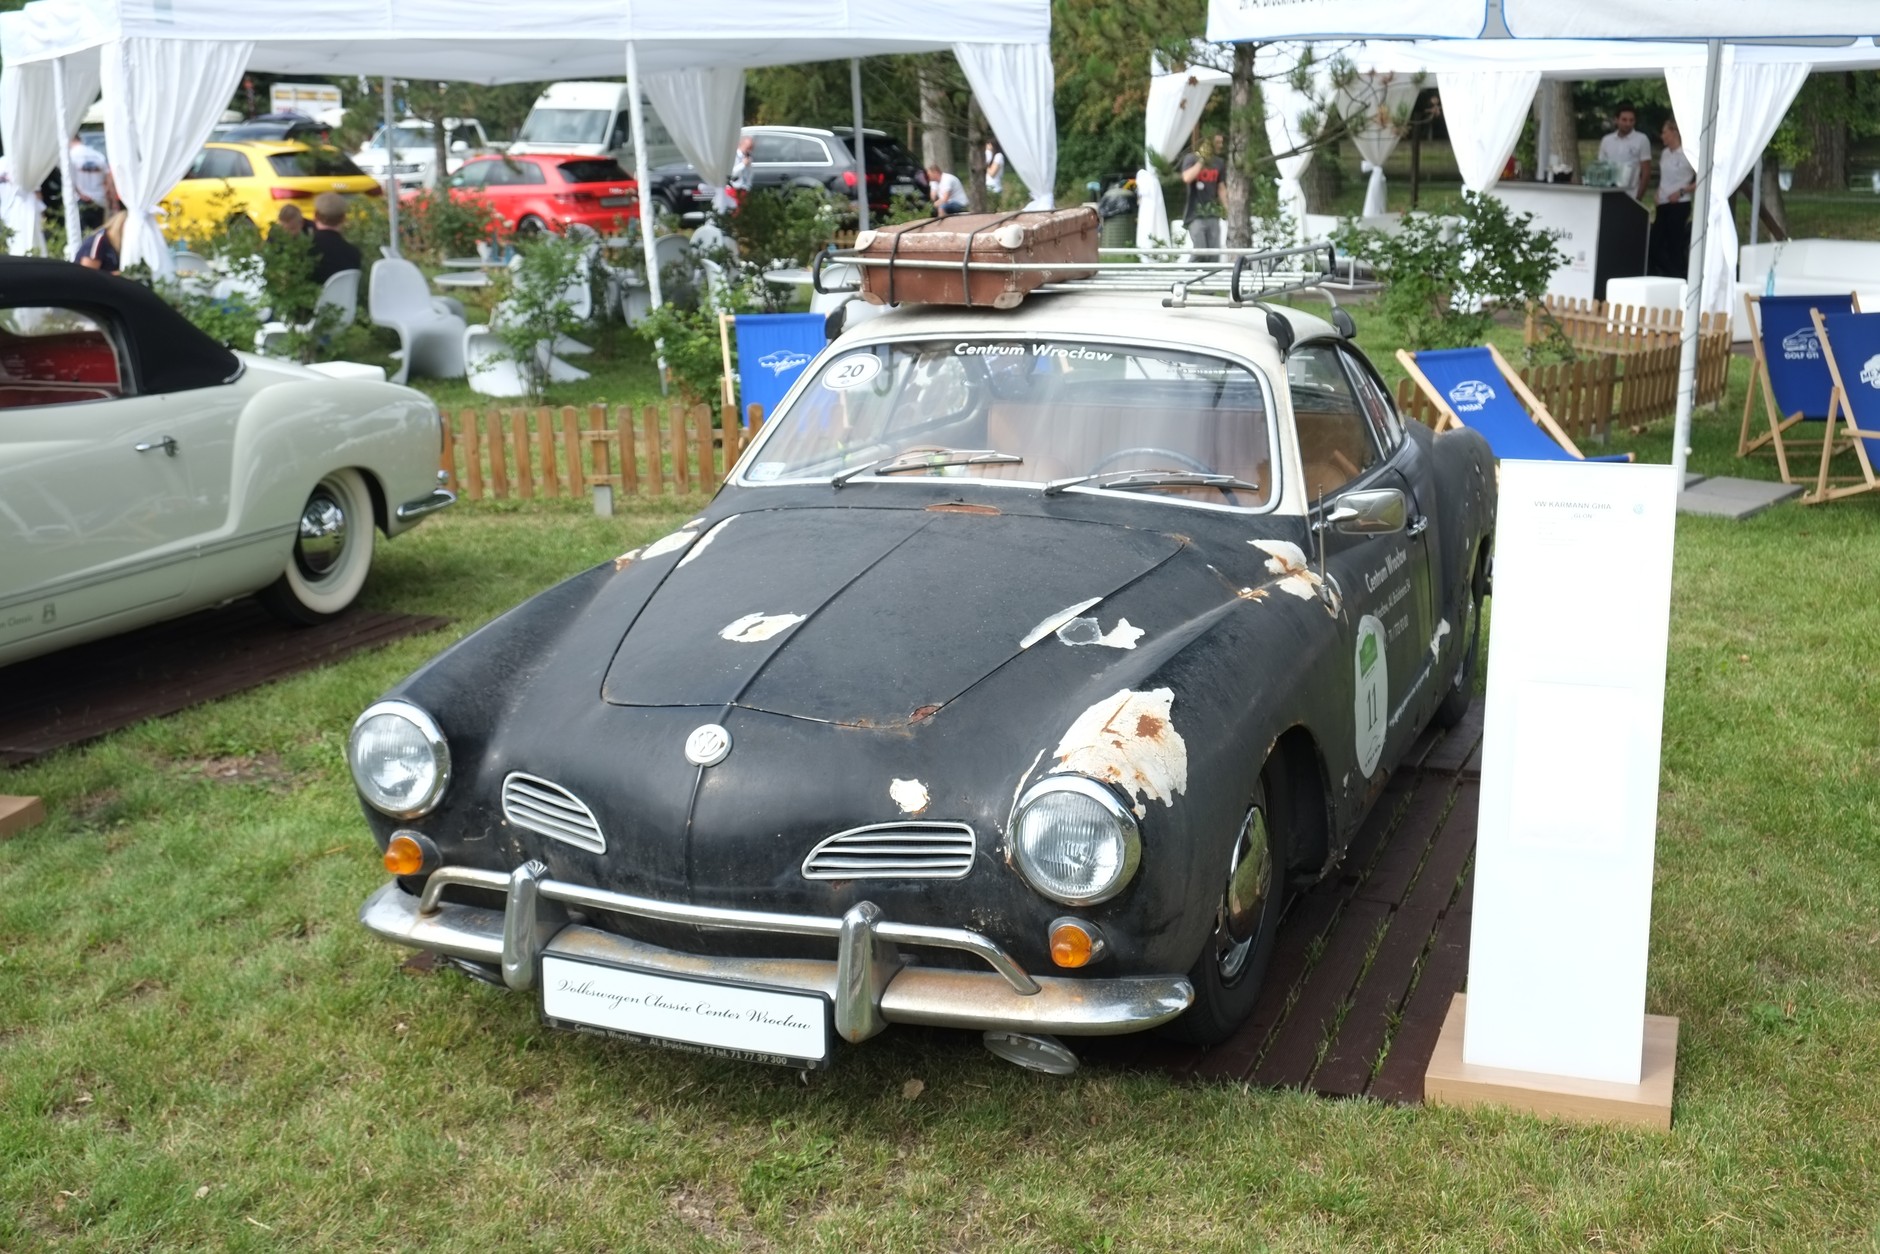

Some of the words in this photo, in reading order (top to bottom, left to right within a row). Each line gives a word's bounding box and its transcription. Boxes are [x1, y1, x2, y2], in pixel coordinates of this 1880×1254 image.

[953, 342, 1025, 356] Centrum
[1031, 344, 1113, 362] Wrocław
[1784, 351, 1805, 360] GOLF
[1806, 351, 1819, 360] GTI
[837, 364, 865, 379] 20
[1534, 500, 1547, 508] VW
[1548, 501, 1589, 510] KARMANN
[1591, 503, 1611, 511] GHIA
[1364, 566, 1388, 594] Centrum
[1366, 682, 1378, 732] 11
[557, 979, 640, 1010] Volkswagen
[644, 993, 692, 1012] Classic
[695, 1000, 740, 1019] Center
[574, 1023, 606, 1037] Centrum
[649, 1037, 660, 1046] Al.
[703, 1046, 714, 1055] 54
[715, 1048, 729, 1058] tel.
[730, 1050, 741, 1059] 71
[743, 1052, 754, 1061] 77
[757, 1053, 768, 1062] 39
[770, 1055, 788, 1065] 300
